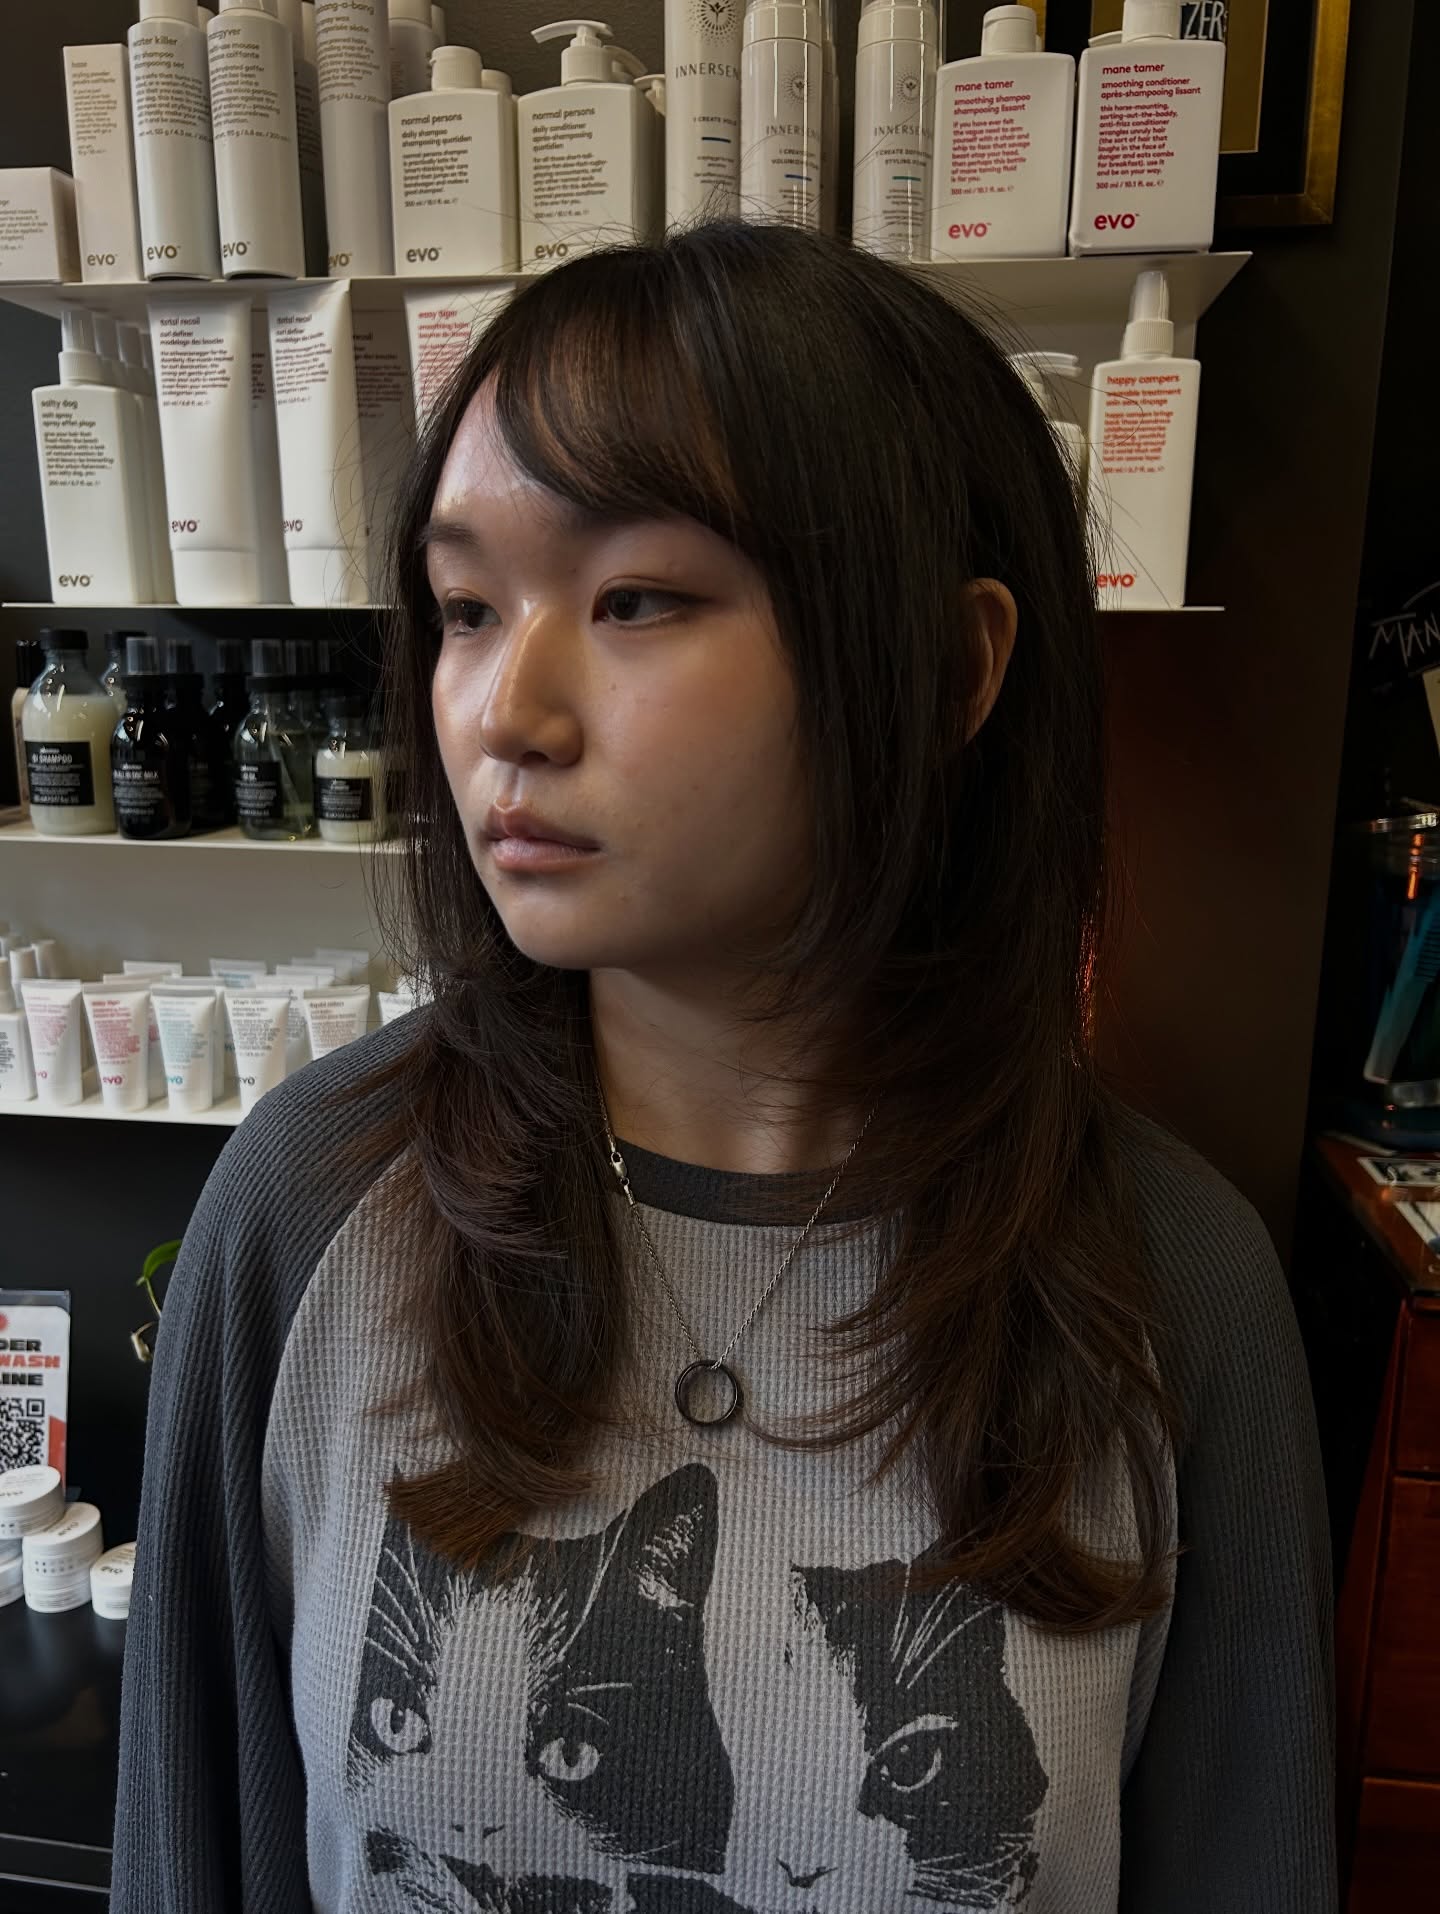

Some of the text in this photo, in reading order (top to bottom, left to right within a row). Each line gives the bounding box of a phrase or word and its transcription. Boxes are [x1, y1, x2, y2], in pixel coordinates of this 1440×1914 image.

[155, 36, 177, 45] killer
[1103, 63, 1165, 74] mane tamer
[955, 79, 1014, 92] mane tamer
[1101, 76, 1190, 90] smoothing conditioner
[1101, 85, 1201, 100] après-shampooing lissant
[954, 93, 1030, 107] smoothing shampoo
[532, 109, 595, 120] normal persons
[954, 103, 1025, 117] shampooing lissant
[401, 115, 462, 125] normal persons
[549, 122, 586, 131] conditioner
[1100, 118, 1169, 128] anti-frizz conditioner
[418, 127, 447, 138] shampoo
[1099, 127, 1128, 137] wrangles
[1130, 127, 1150, 136] unruly
[1152, 134, 1167, 142] that
[1098, 144, 1119, 154] laughs
[1129, 143, 1139, 151] the
[1098, 152, 1120, 162] danger
[1152, 150, 1174, 158] combs
[1095, 214, 1135, 230] evo
[948, 223, 987, 239] evo
[147, 245, 177, 260] evo
[407, 247, 439, 263] evo
[535, 243, 567, 258] evo
[87, 253, 115, 267] evo
[1107, 374, 1180, 386] happy campers
[171, 519, 197, 533] evo
[58, 574, 91, 587] evo
[1097, 573, 1134, 589] evo
[0, 1373, 43, 1386] INE
